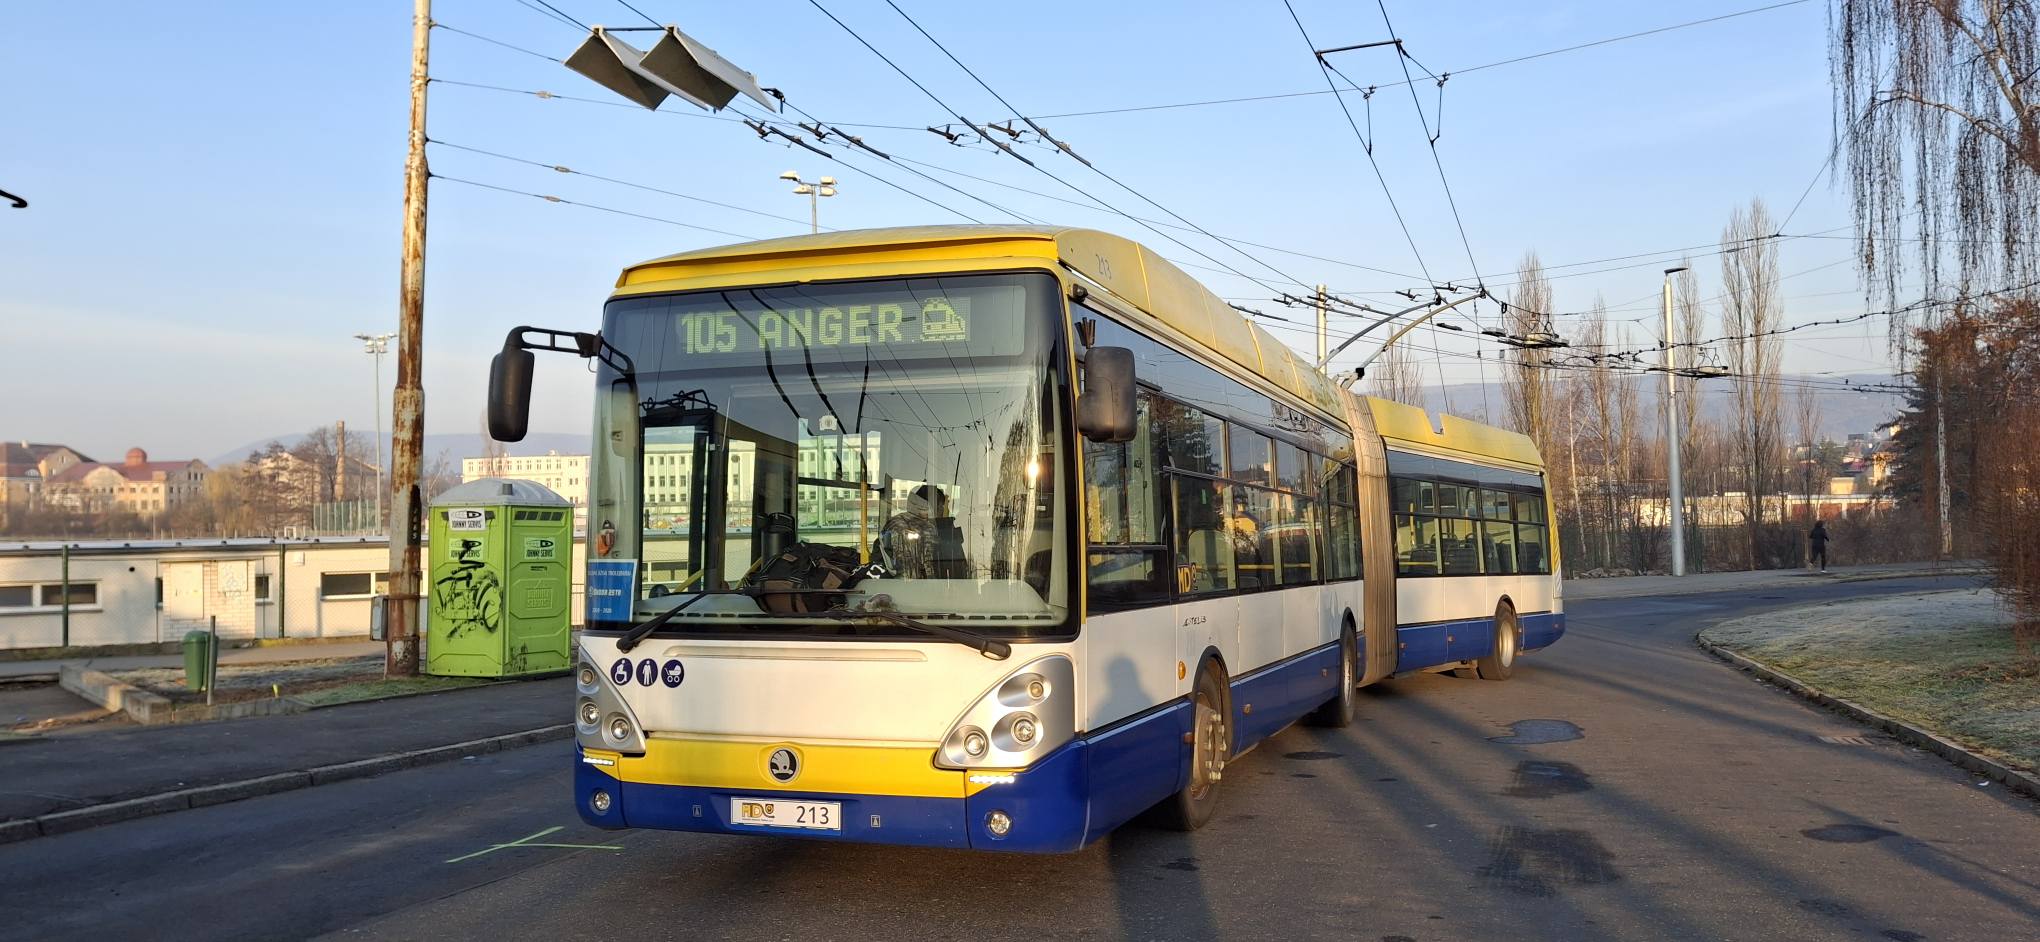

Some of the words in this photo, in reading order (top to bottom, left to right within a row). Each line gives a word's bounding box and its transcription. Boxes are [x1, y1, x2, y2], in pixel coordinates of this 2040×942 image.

[680, 311, 737, 354] 105
[759, 303, 903, 348] ANGER
[468, 519, 482, 529] SERVIS
[796, 805, 829, 825] 213
